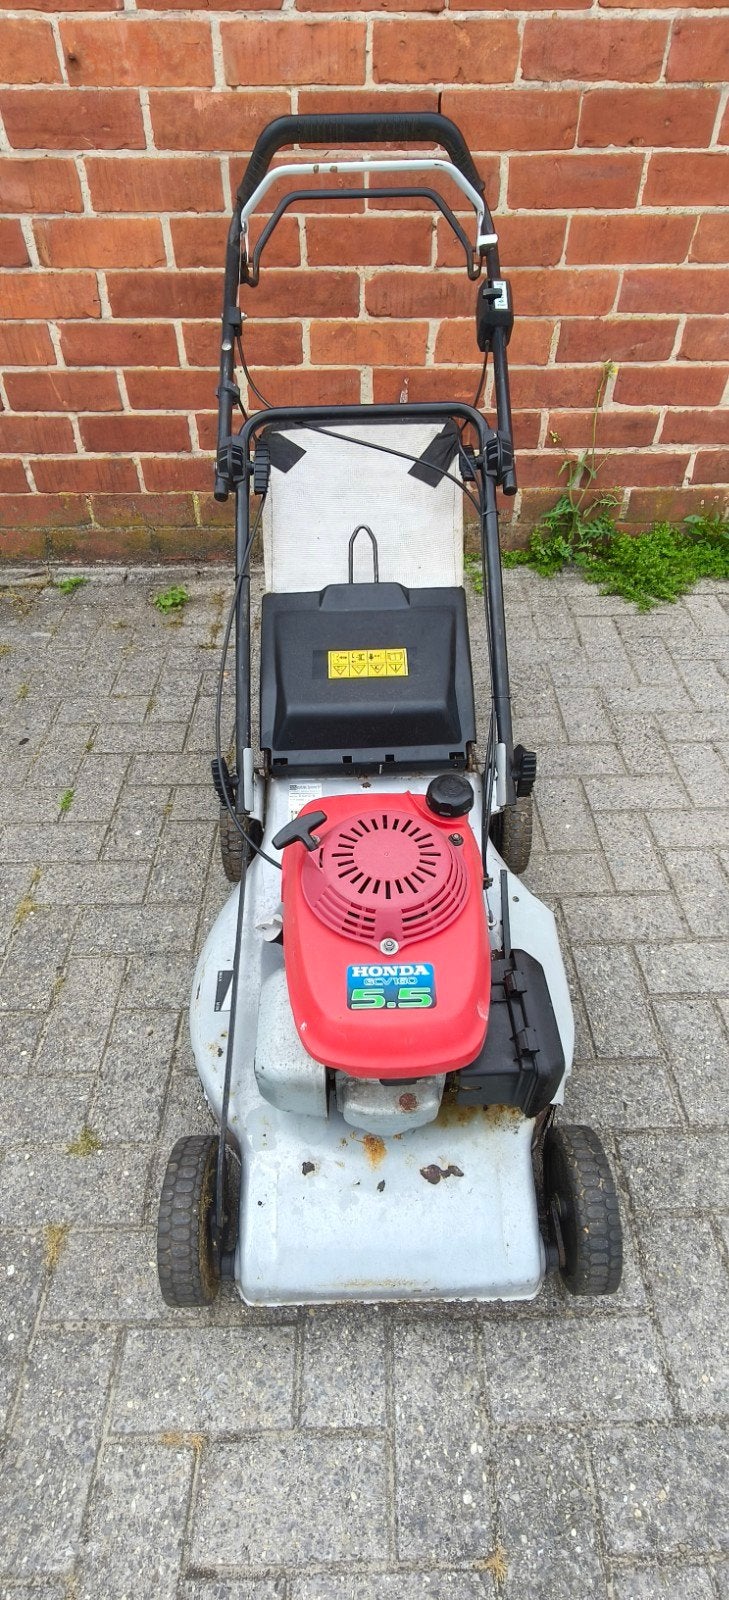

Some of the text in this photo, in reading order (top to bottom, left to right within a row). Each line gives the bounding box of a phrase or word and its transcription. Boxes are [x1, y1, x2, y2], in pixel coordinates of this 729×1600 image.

[352, 965, 430, 977] HONDA
[363, 977, 418, 986] GCV160
[351, 987, 432, 1009] 5.5
